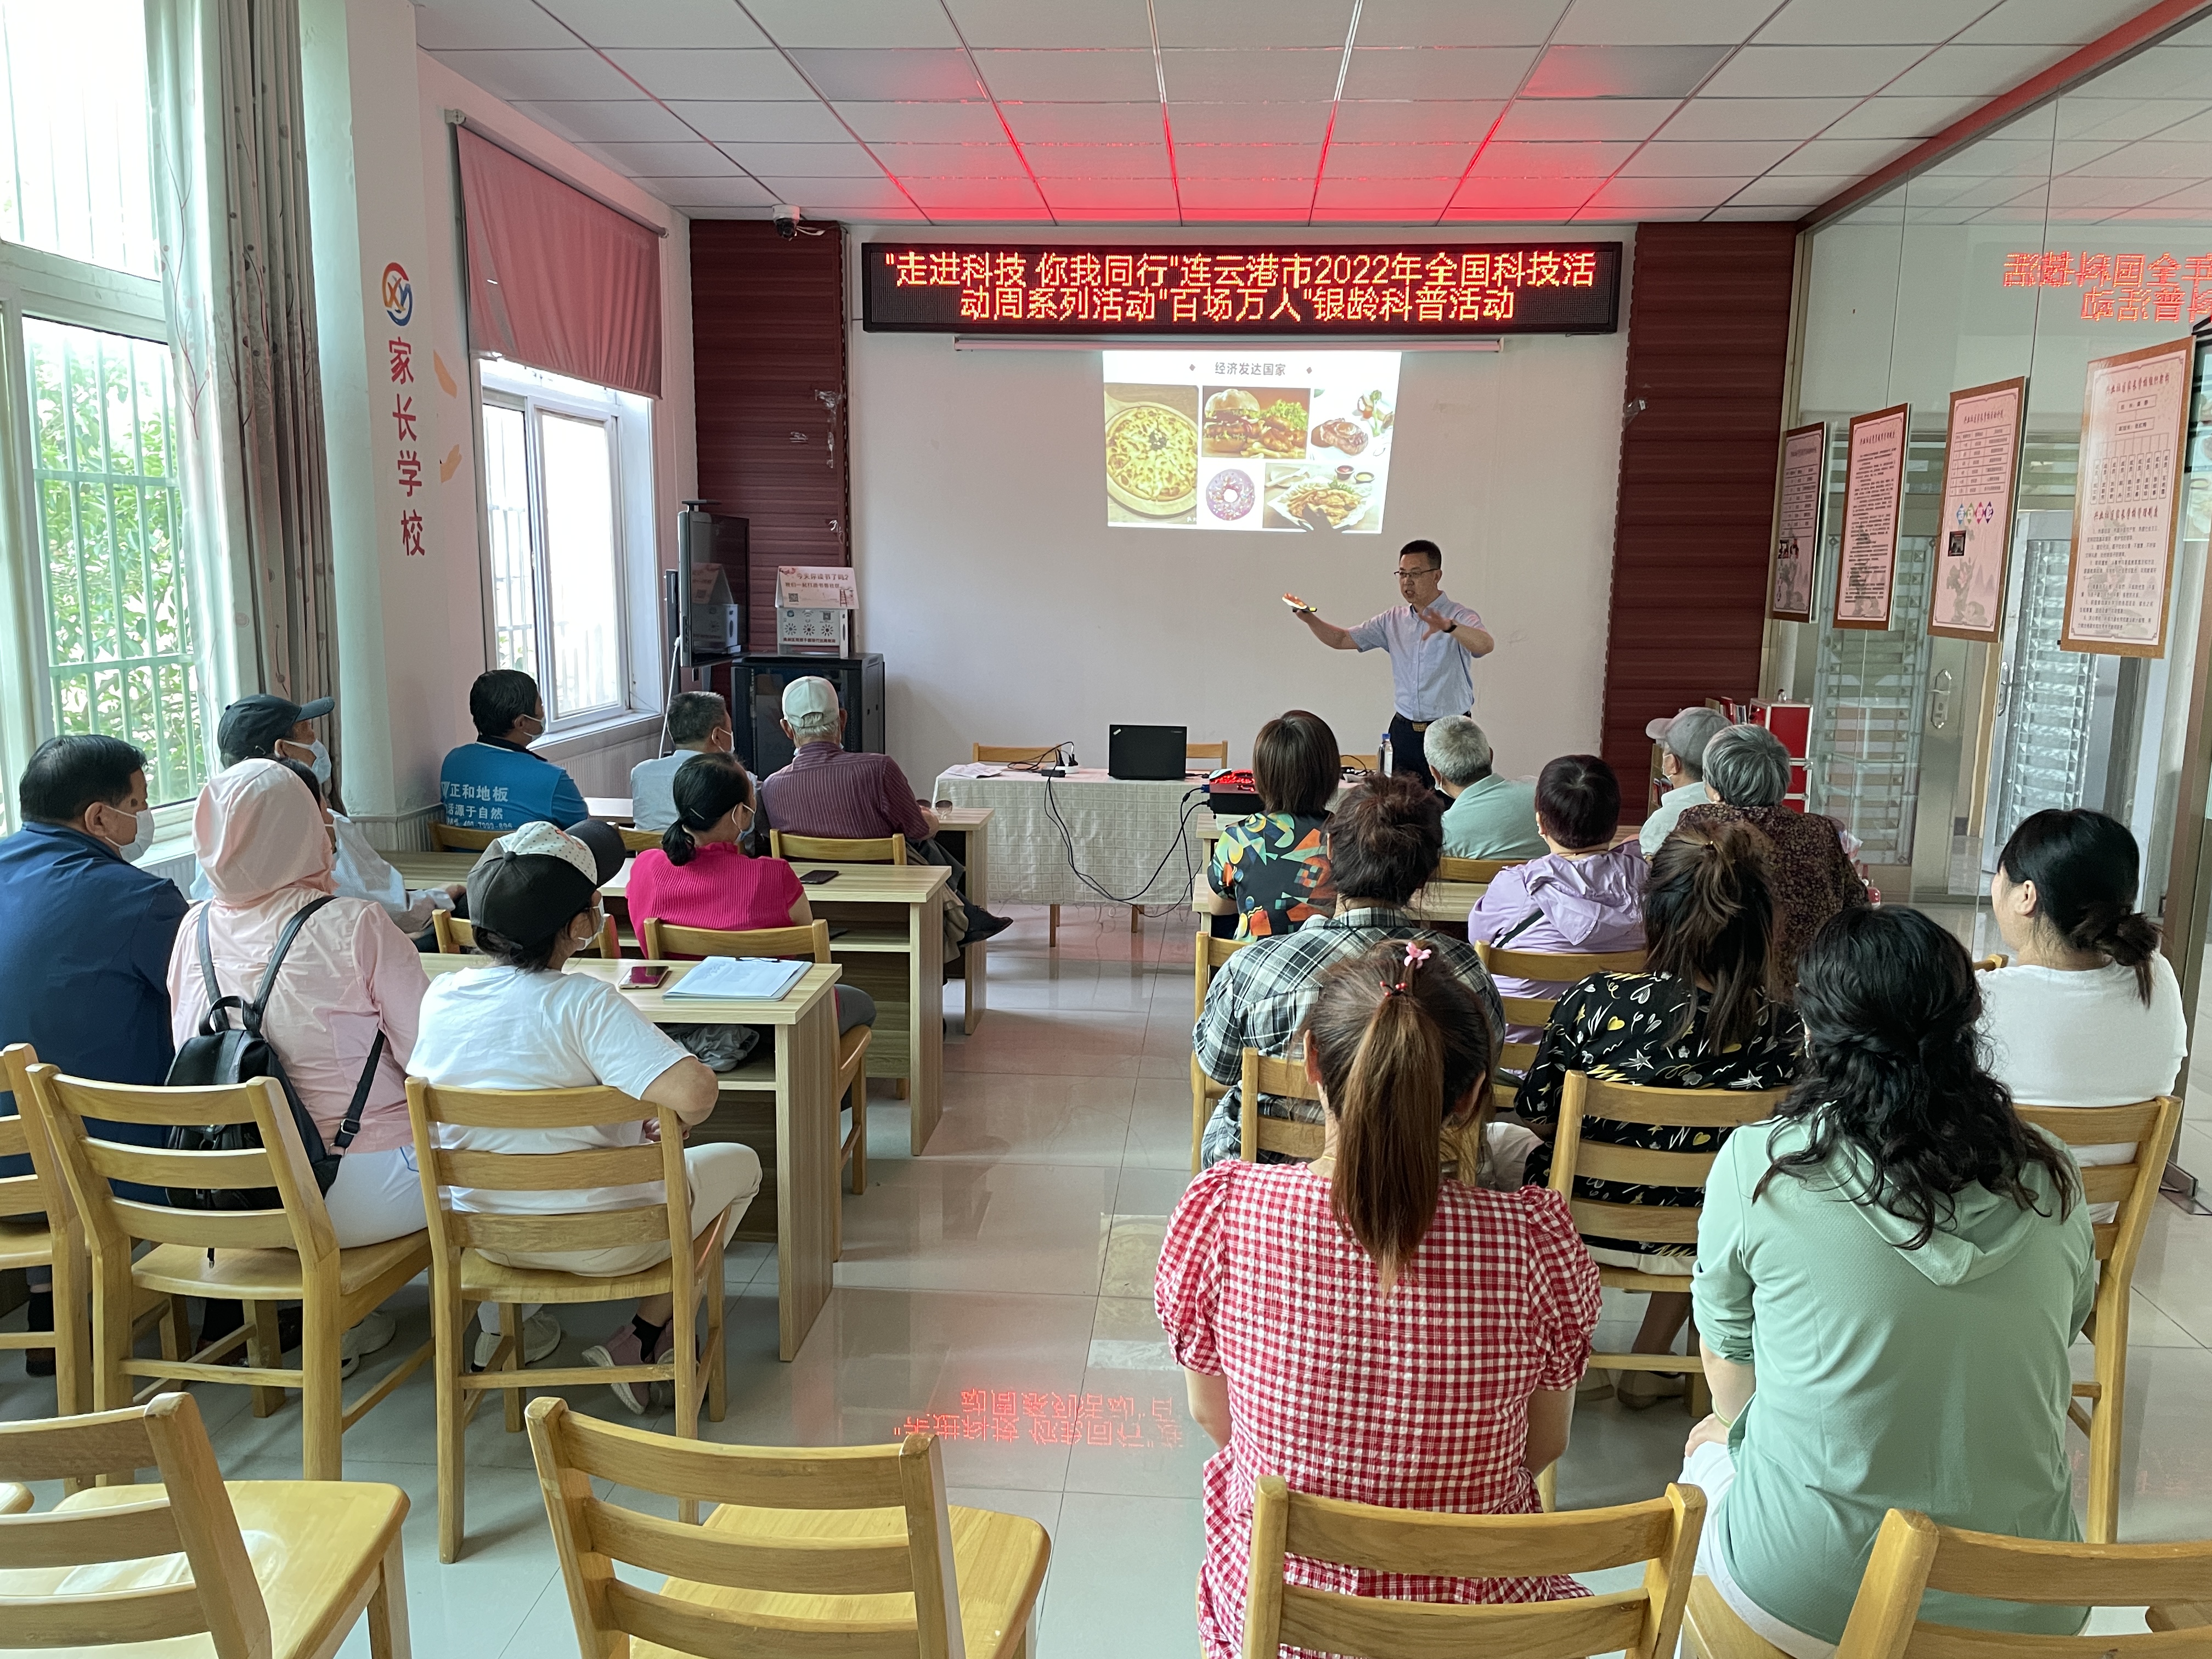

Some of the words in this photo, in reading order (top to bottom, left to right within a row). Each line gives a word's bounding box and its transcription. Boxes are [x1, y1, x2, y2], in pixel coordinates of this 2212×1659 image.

[1215, 362, 1286, 376] 经济发达国家
[388, 336, 425, 556] 家长学校
[450, 783, 509, 802] 正和地板
